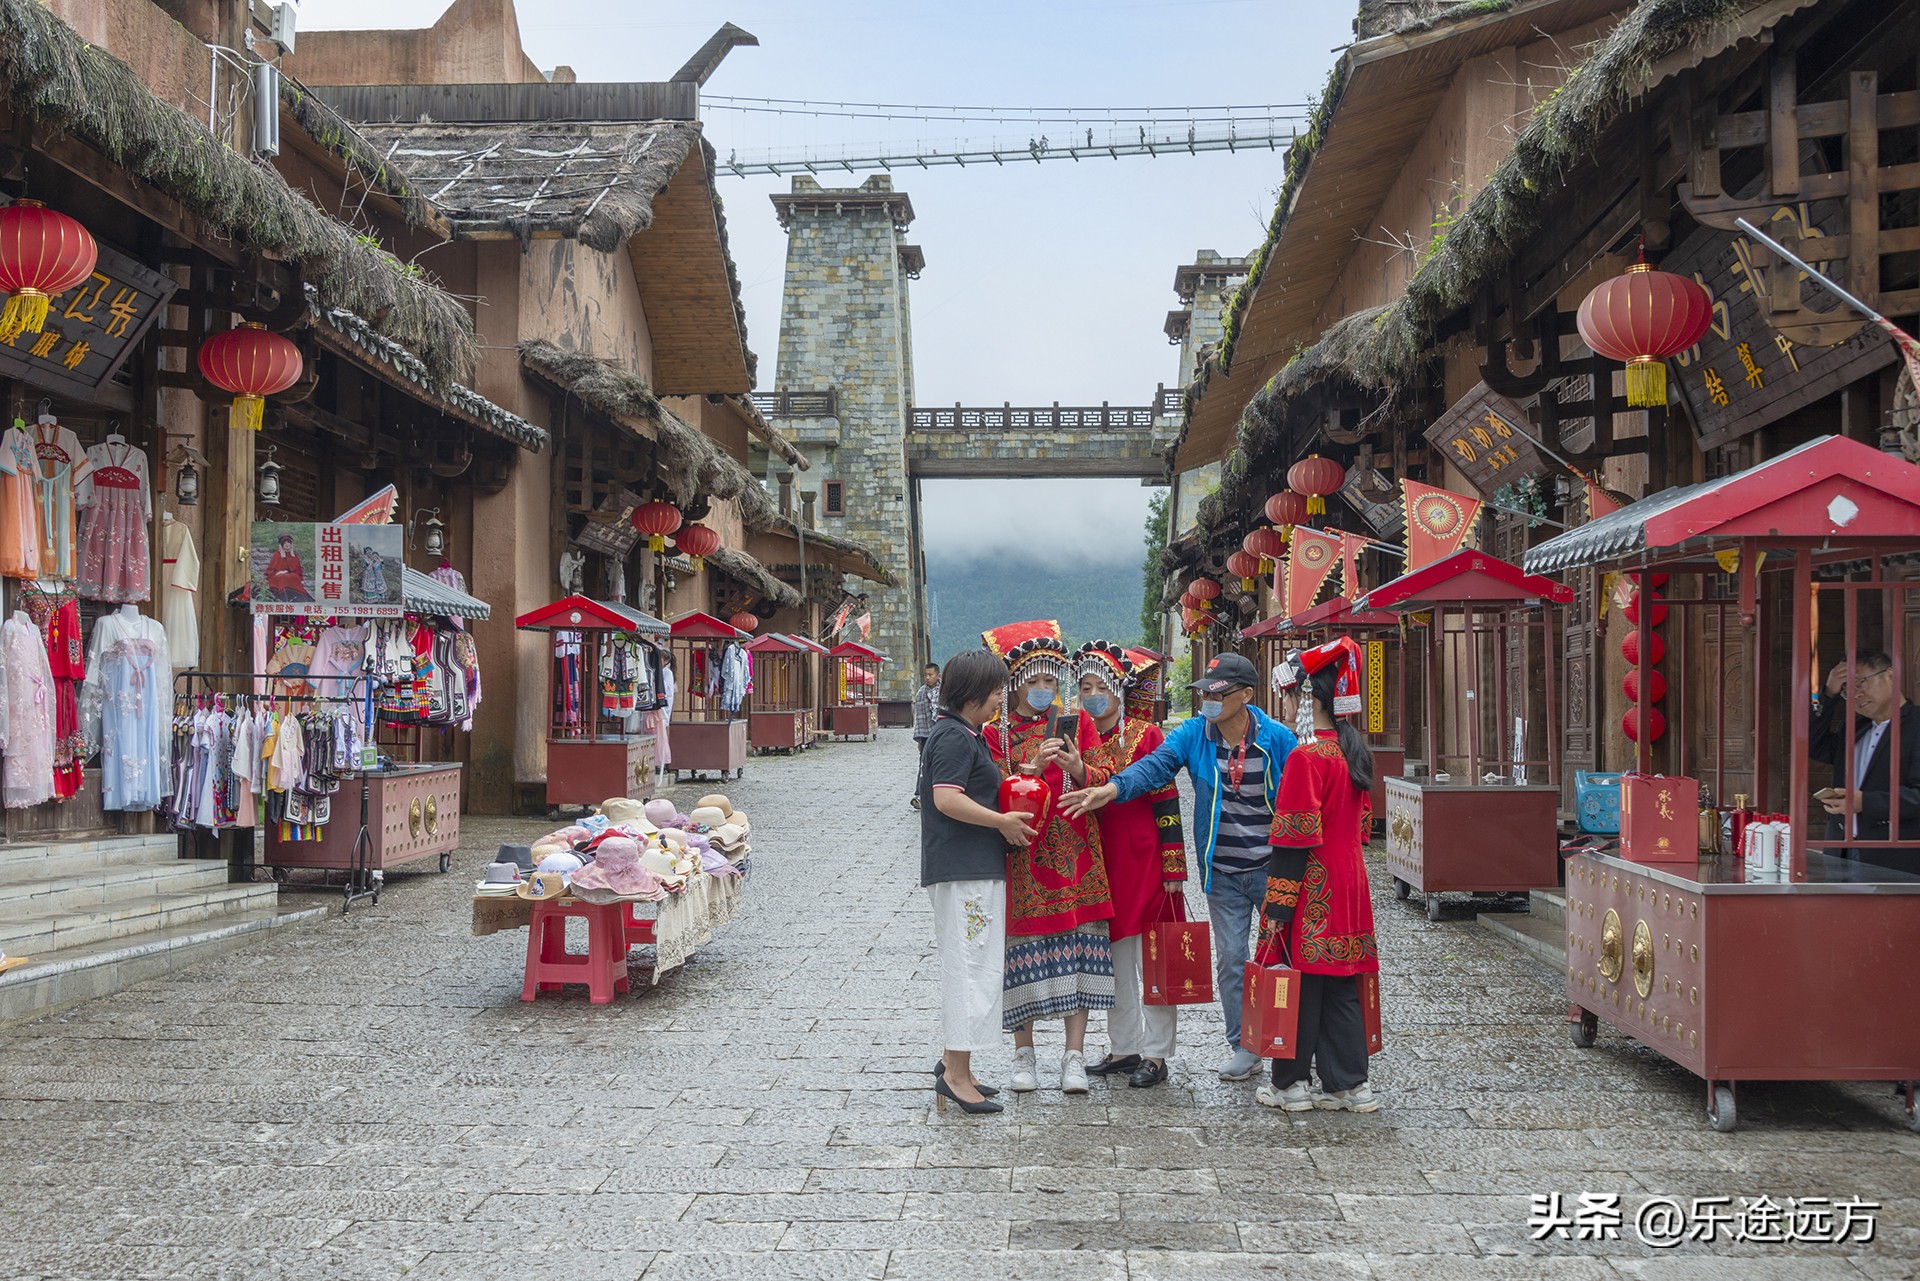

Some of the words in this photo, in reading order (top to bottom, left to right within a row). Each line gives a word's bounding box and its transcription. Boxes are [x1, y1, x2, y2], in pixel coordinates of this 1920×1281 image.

[321, 526, 343, 600] 出租出售
[255, 604, 295, 613] 彝族服饰
[333, 606, 350, 614] 155
[353, 606, 373, 615] 1981
[376, 607, 399, 615] 6899
[1208, 680, 1229, 691] CHINA
